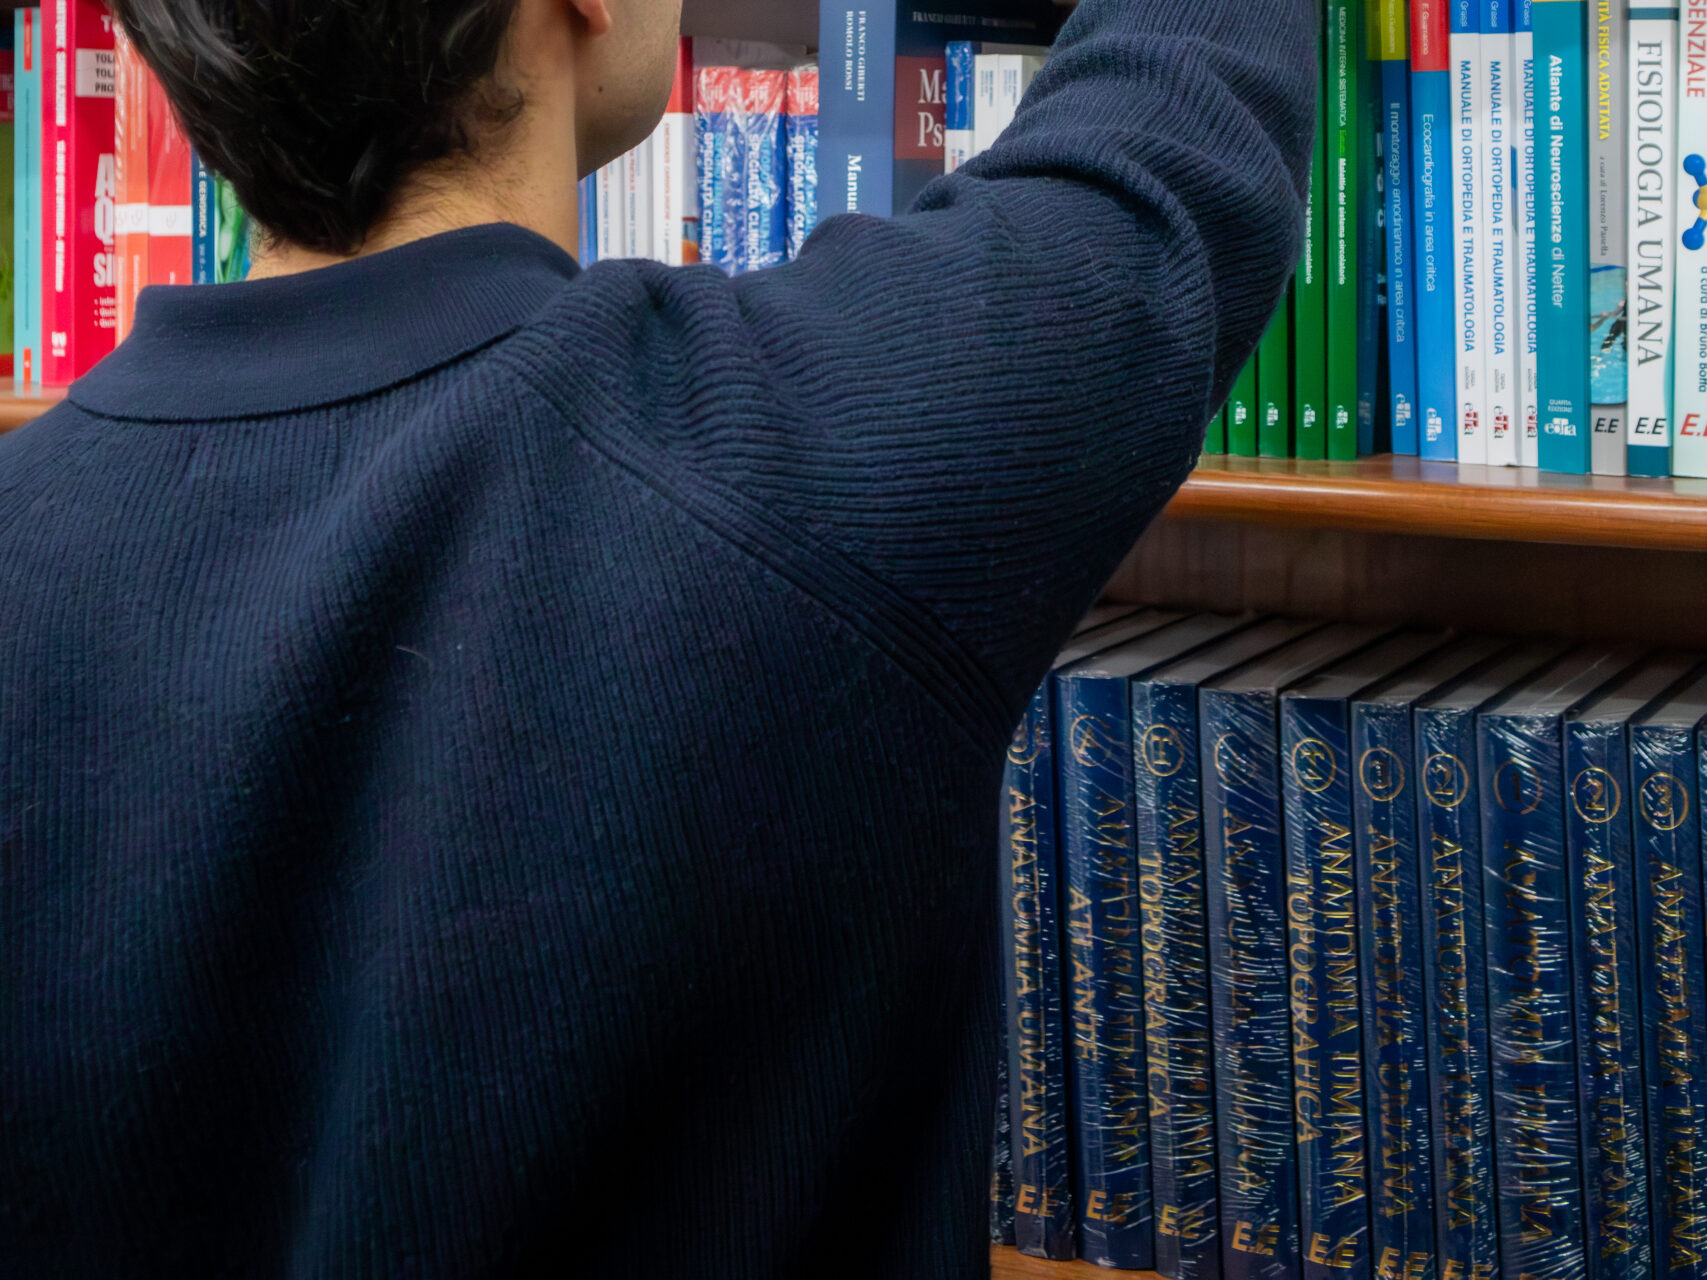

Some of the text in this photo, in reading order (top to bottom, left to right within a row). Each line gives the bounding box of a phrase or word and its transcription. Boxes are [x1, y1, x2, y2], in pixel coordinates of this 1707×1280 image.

[844, 10, 854, 91] ROMOLO ROSSI
[856, 10, 867, 101] FRANCO GIBERTI
[1339, 7, 1347, 43] MEDICINA
[1598, 28, 1611, 70] FISICA
[1339, 78, 1347, 126] SISTEMATICA
[1459, 60, 1473, 124] MANUALE
[1491, 60, 1502, 125] MANUALE
[1523, 59, 1535, 124] MANUALE
[1598, 73, 1612, 140] ADATTATA
[702, 132, 715, 206] SPECIALITÀ
[747, 133, 761, 206] SPECIALITÀ
[1460, 127, 1472, 140] DI
[1492, 128, 1502, 142] DI
[1523, 127, 1535, 141] DI
[1420, 114, 1438, 290] Ecocardiografia in area critica
[1460, 145, 1474, 220] ORTOPEDIA
[1492, 146, 1504, 222] ORTOPEDIA
[1523, 144, 1536, 220] ORTOPEDIA
[1548, 53, 1567, 306] Atlante di Neuroscienze di Netter
[1636, 41, 1664, 367] FISIOLOGIA UMANA
[1339, 158, 1347, 284] Malattie del sistema circolatorio
[1461, 237, 1476, 350] TRAUMATOLOGIA
[1493, 239, 1505, 353] TRAUMATOLOGIA
[1525, 238, 1537, 353] TRAUMATOLOGIA
[1632, 417, 1668, 436] E.E
[1009, 787, 1048, 1158] ANATOMIA UMANA
[1137, 851, 1171, 1118] TOPOGRAFICA
[1286, 870, 1323, 1145] TOPOGRAFICA
